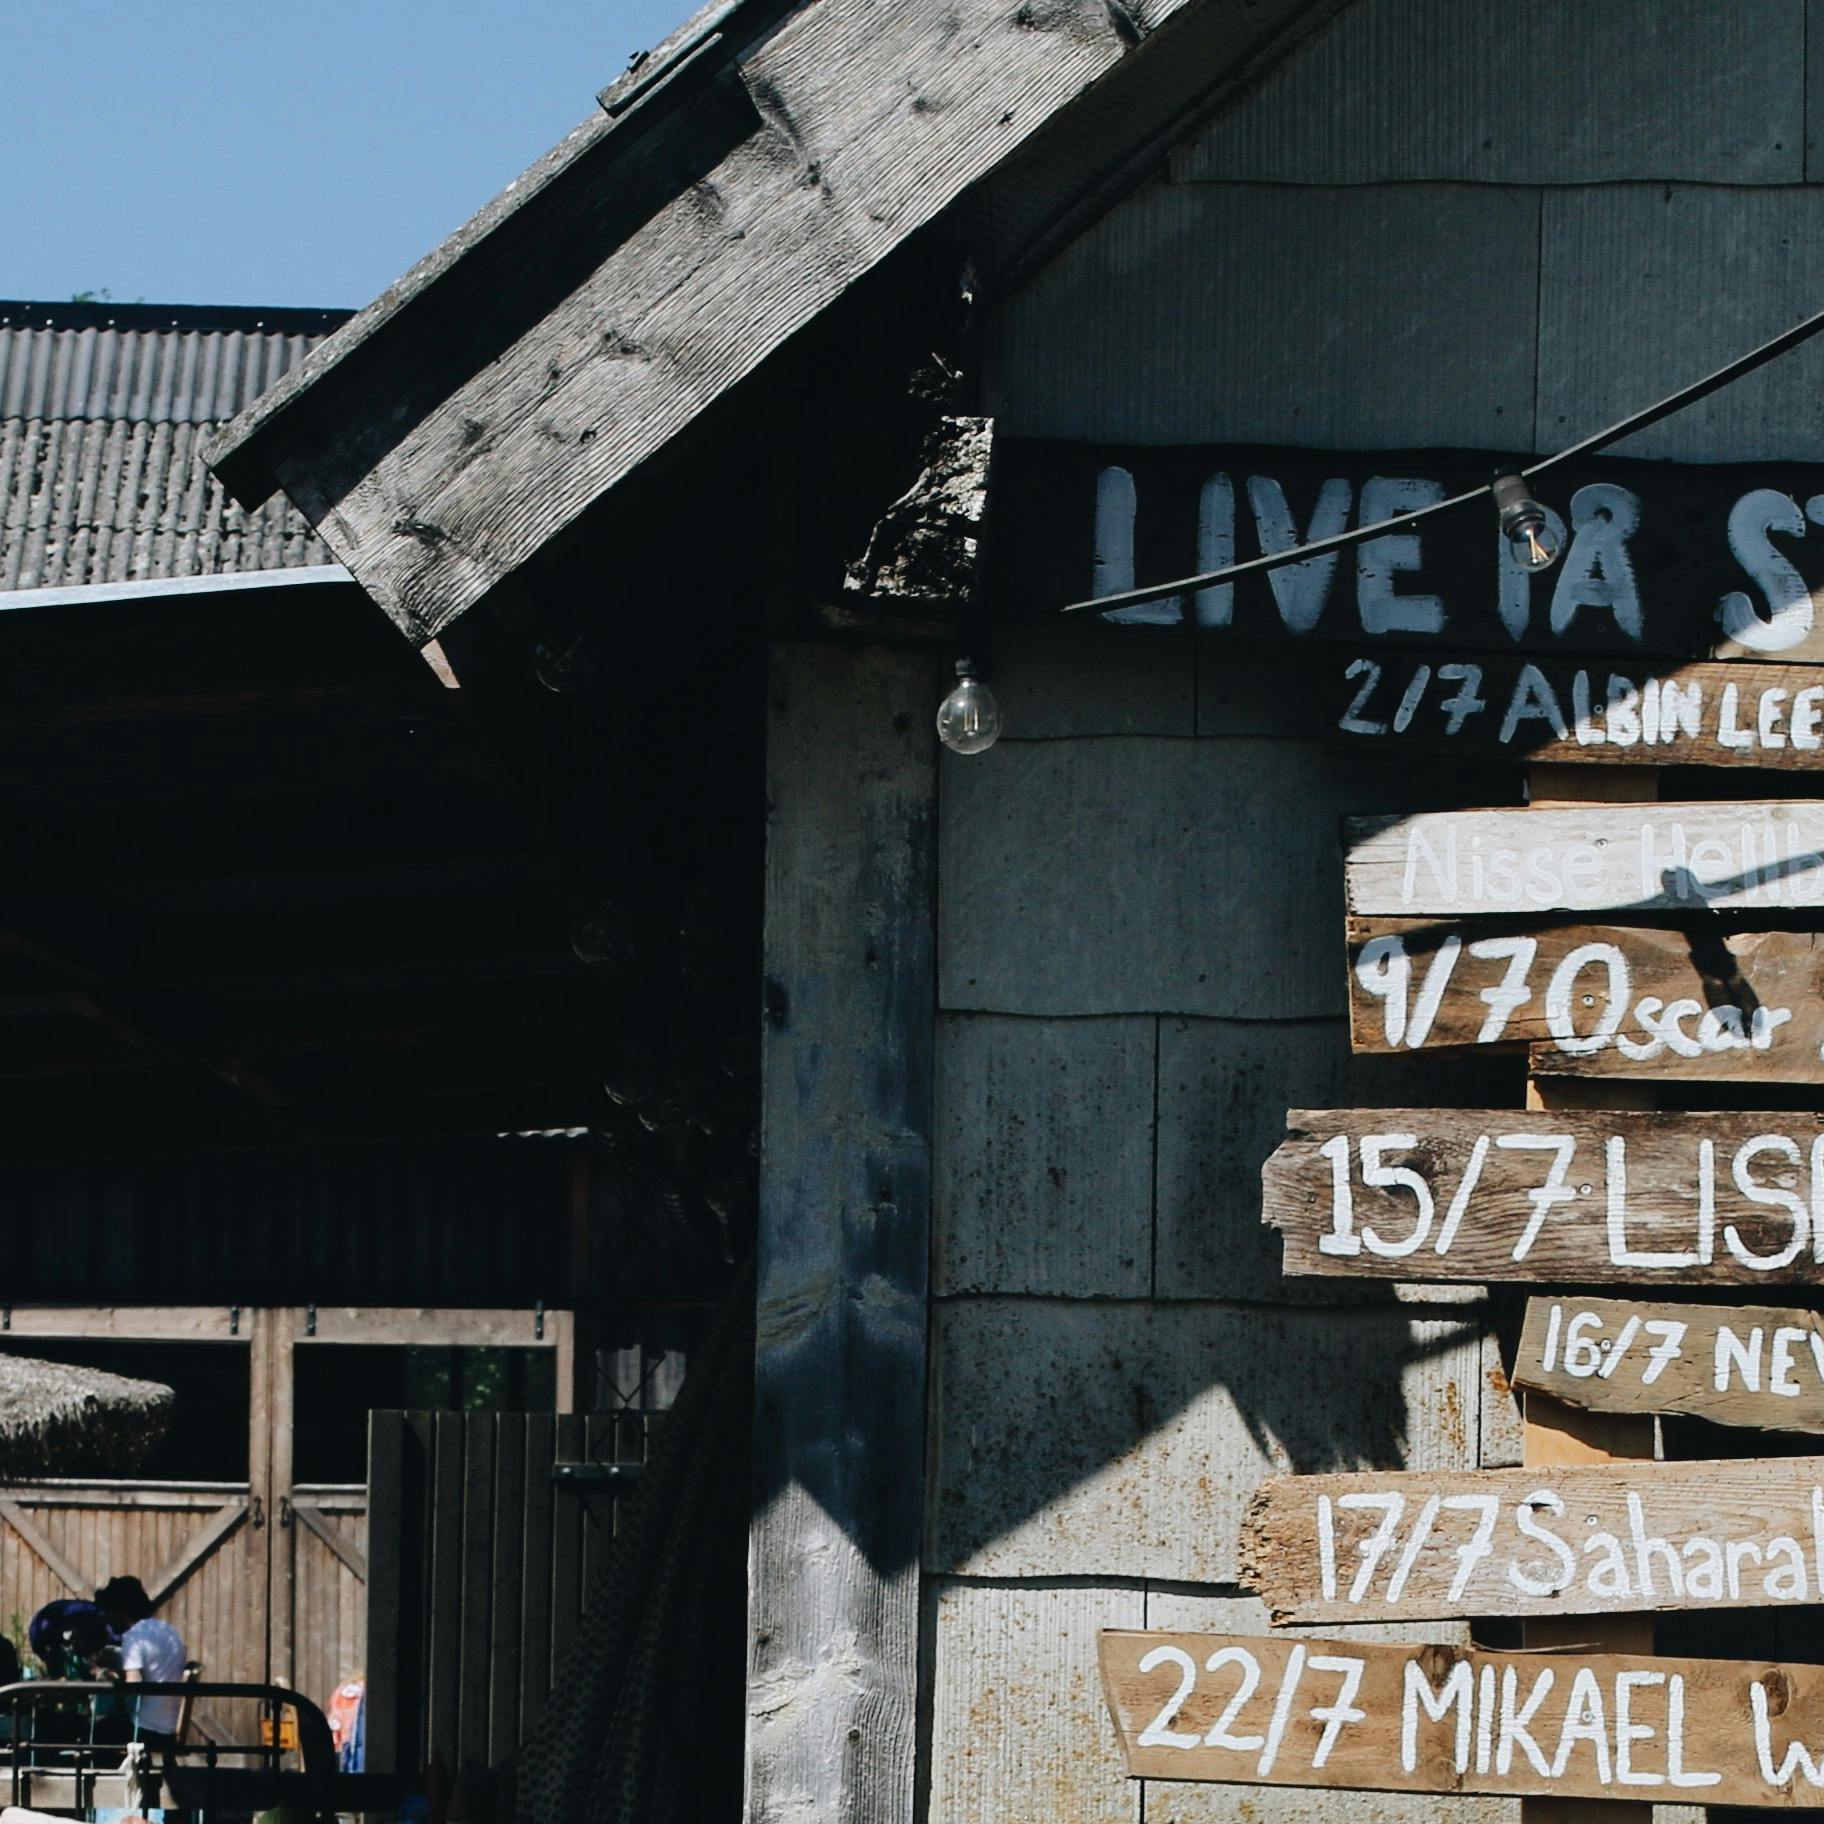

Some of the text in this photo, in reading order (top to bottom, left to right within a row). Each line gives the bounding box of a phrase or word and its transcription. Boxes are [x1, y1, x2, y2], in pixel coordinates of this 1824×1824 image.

[1090, 464, 1446, 635] LIVE
[1497, 482, 1644, 642] PÅ
[1338, 659, 1487, 736] 2/7
[1498, 662, 1703, 748] ALBIN
[1402, 826, 1604, 904] Nisse
[1353, 934, 1538, 1049] 9/7
[1544, 942, 1792, 1062] Oscar
[1317, 1132, 1578, 1261] 15/7
[1542, 1303, 1690, 1386] 16/7
[1316, 1490, 1498, 1604] 17/7
[1136, 1642, 1368, 1777] 22/7
[1402, 1660, 1722, 1788] MIKAEL
